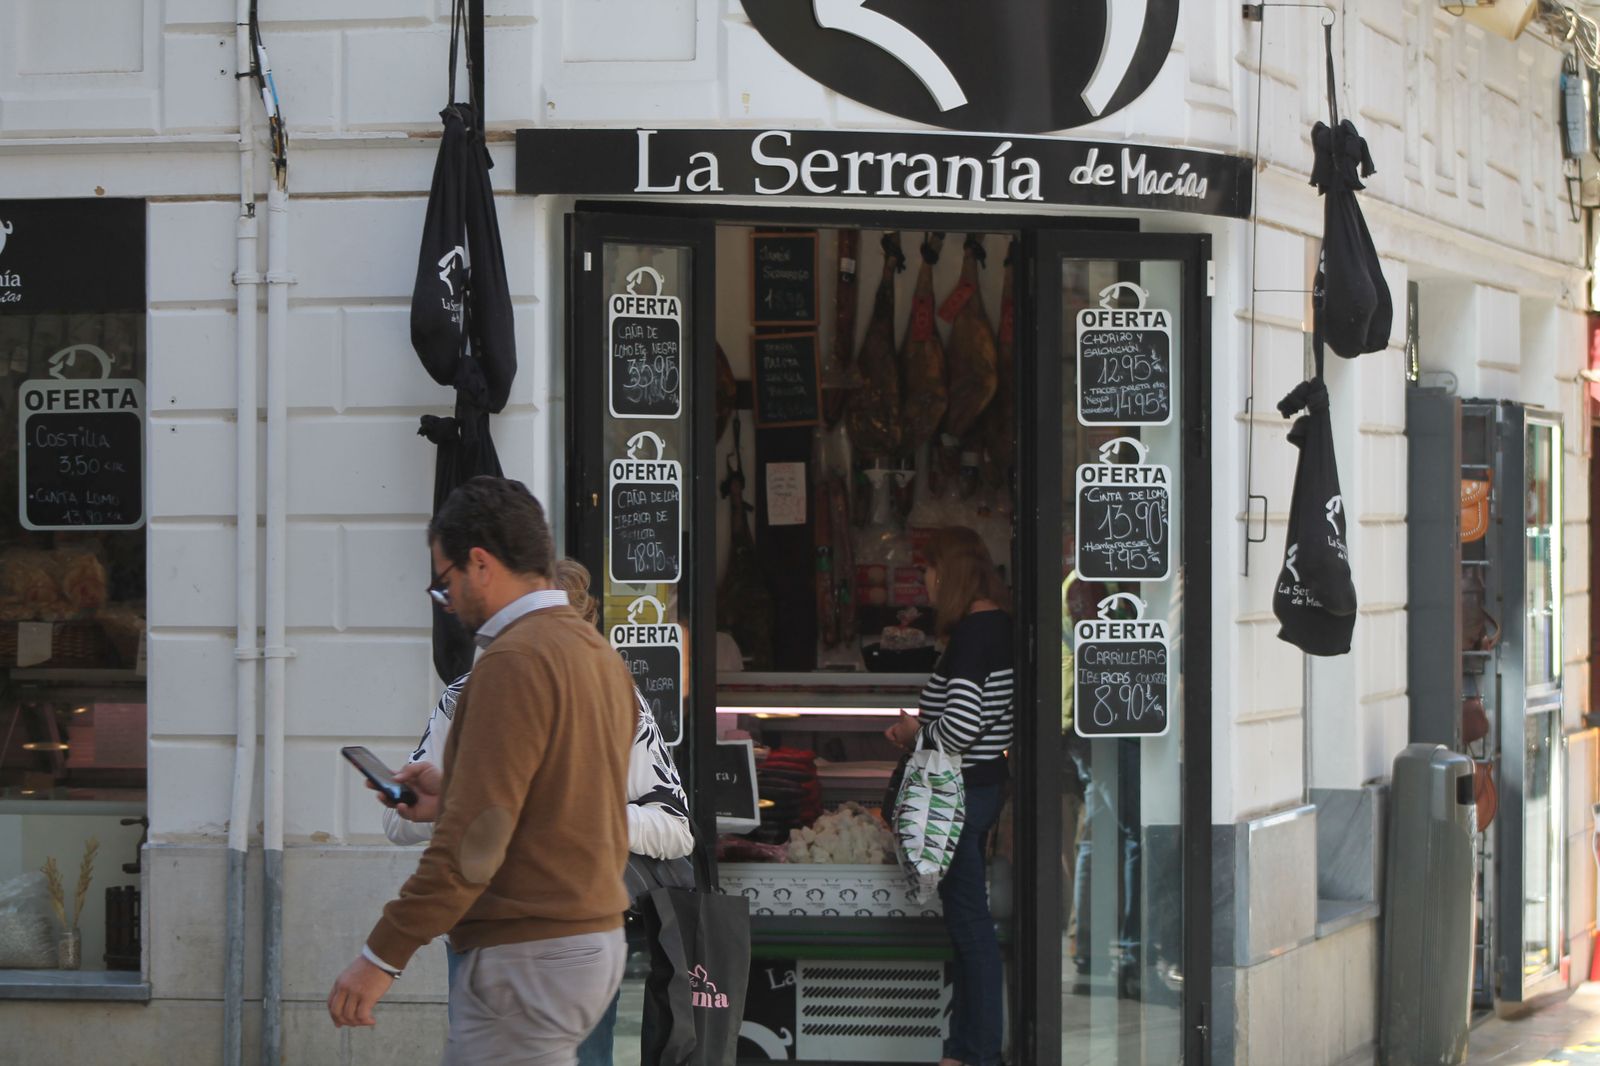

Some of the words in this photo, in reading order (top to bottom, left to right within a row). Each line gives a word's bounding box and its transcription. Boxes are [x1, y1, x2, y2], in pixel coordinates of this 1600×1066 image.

[634, 130, 724, 194] La
[750, 130, 1044, 202] Serranía
[1069, 148, 1117, 187] de
[1120, 147, 1209, 200] Macías
[613, 297, 679, 316] OFERTA
[1081, 311, 1167, 328] OFERTA
[646, 325, 659, 339] DE
[25, 388, 139, 411] OFERTA
[613, 463, 679, 481] OFERTA
[1081, 466, 1167, 484] OFERTA
[617, 489, 648, 509] CAÑA
[1128, 491, 1144, 501] DE
[656, 510, 669, 523] DE
[1278, 582, 1290, 595] La
[1291, 596, 1303, 605] de
[614, 626, 679, 644] OFERTA
[1079, 622, 1165, 640] OFERTA
[765, 967, 797, 990] La
